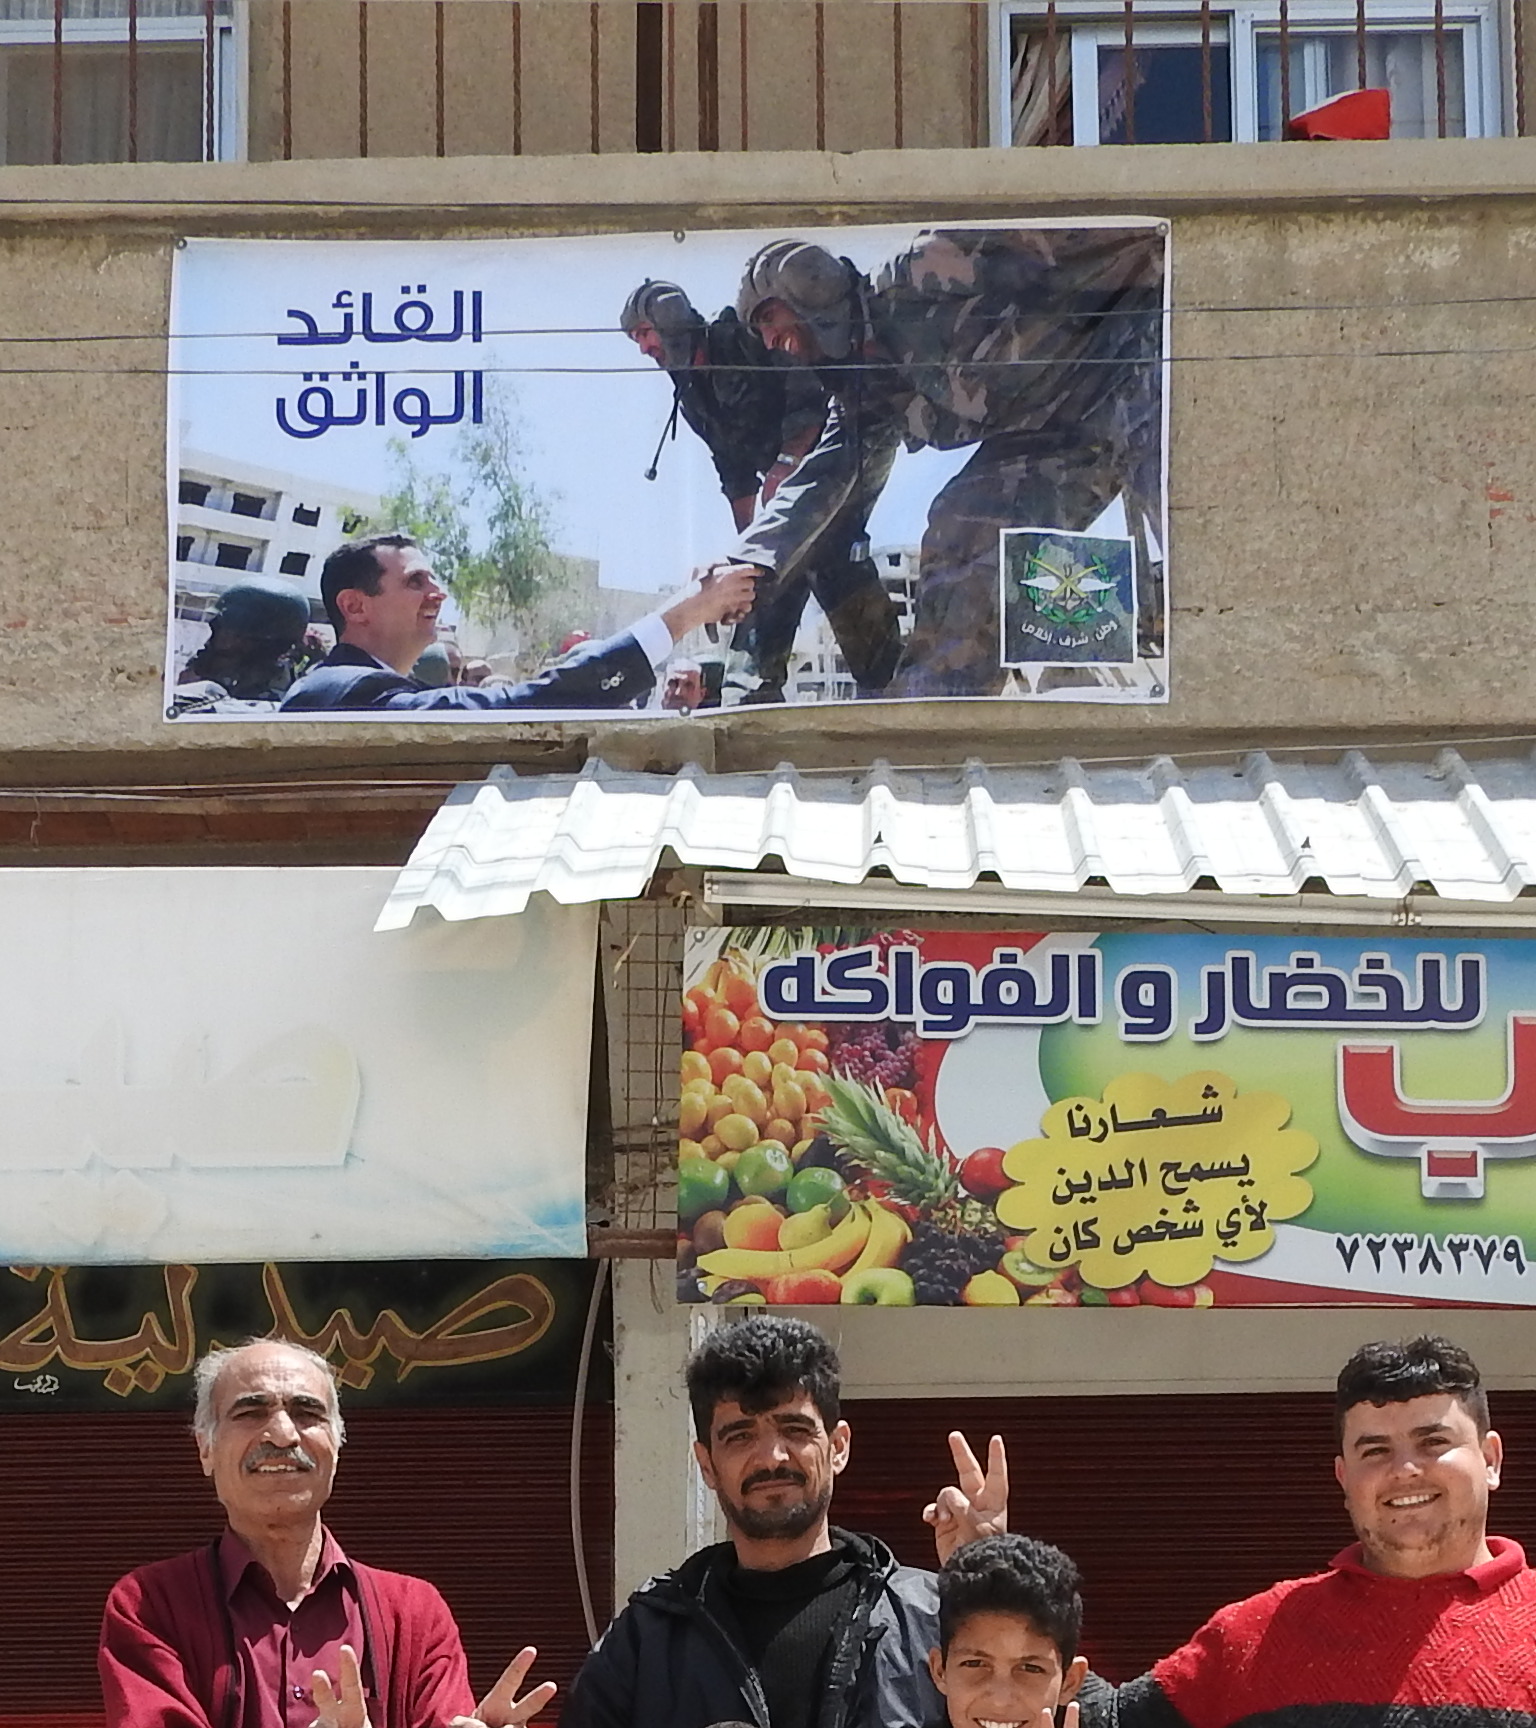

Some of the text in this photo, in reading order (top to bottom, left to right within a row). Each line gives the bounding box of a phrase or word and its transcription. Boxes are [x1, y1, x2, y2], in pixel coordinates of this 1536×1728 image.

[277, 284, 482, 345] القائد
[276, 361, 482, 438] الواثق
[1021, 620, 1118, 648] وطن شرف إخلاص
[764, 951, 1482, 1037] للخضار و الفواكه
[1067, 1084, 1223, 1143] شعارنا
[1052, 1154, 1255, 1204] يسمح الدين
[1049, 1195, 1267, 1261] لأي شخص كان
[1335, 1236, 1525, 1277] ٧٢٣٨٣٧٩
